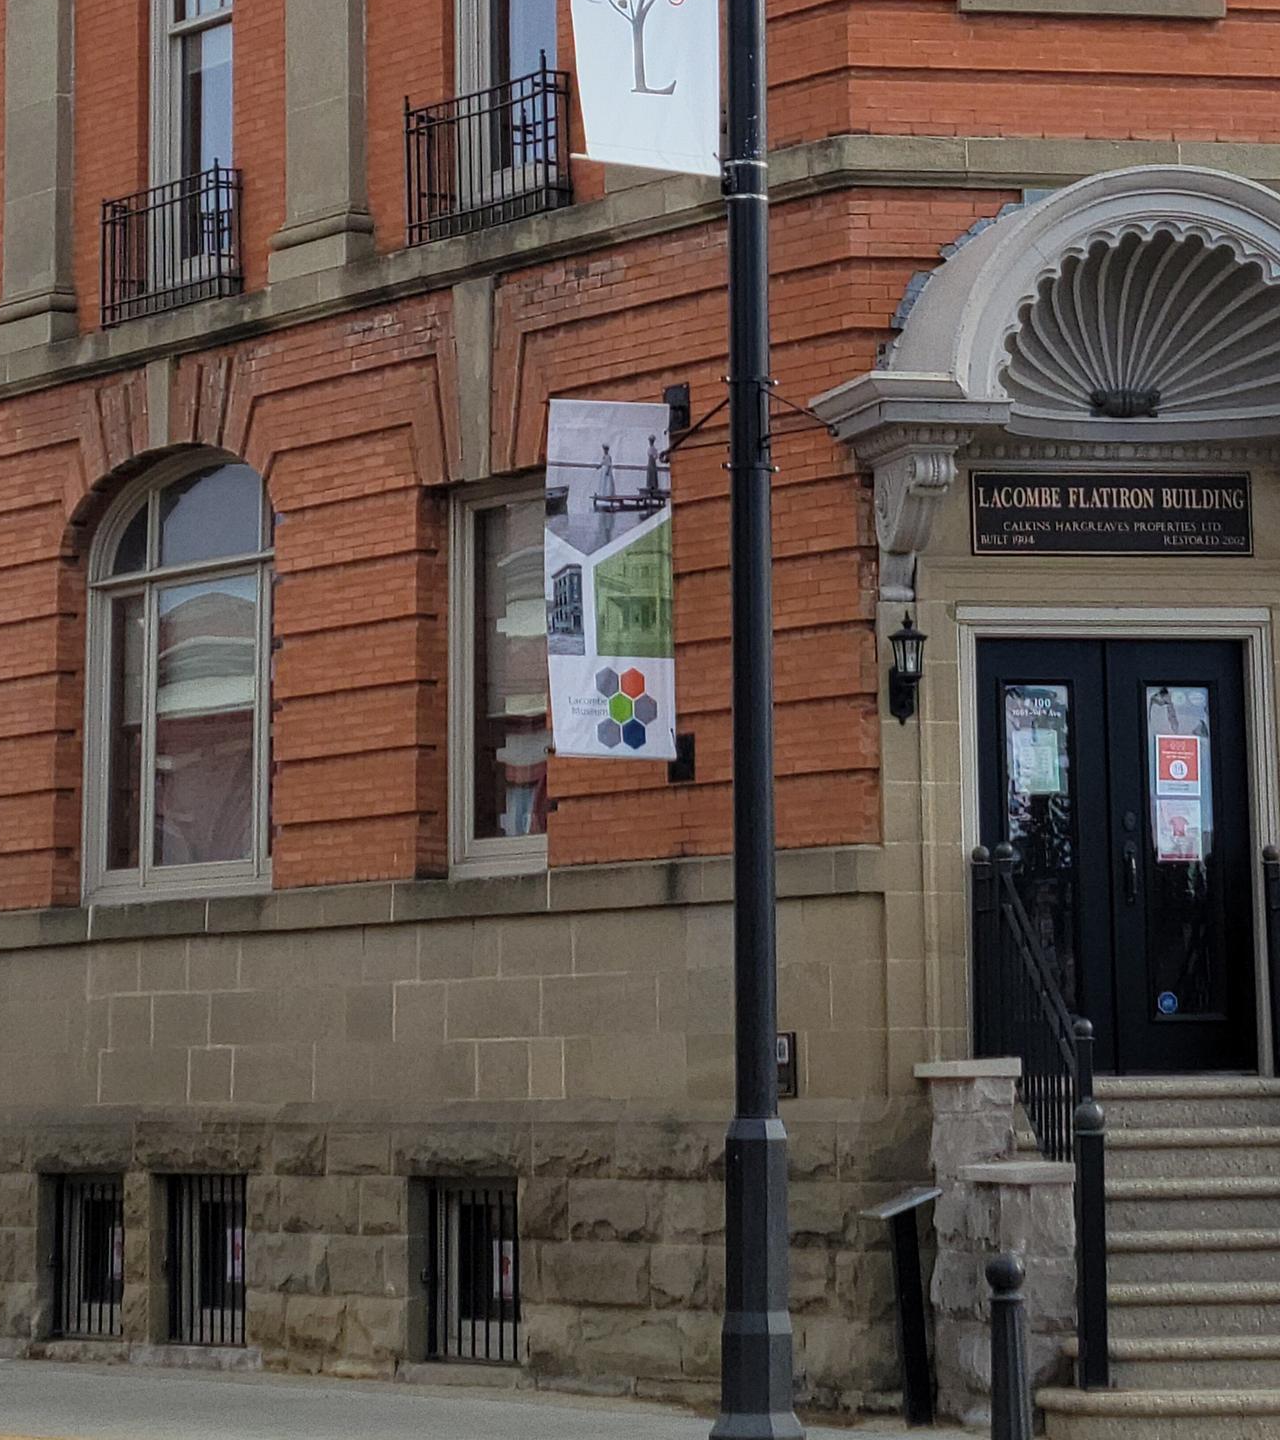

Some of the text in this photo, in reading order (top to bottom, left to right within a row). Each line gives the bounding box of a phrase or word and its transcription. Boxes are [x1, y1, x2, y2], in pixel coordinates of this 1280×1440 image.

[978, 486, 1244, 510] LACOMBE FLATIRON BUILDING
[1003, 521, 1222, 533] CALKINS HARGREAVES PROPERTIES LTD
[980, 534, 1008, 545] BUILT
[1163, 535, 1220, 546] RESTORED
[568, 695, 608, 706] Lacombe
[571, 706, 609, 717] Museum
